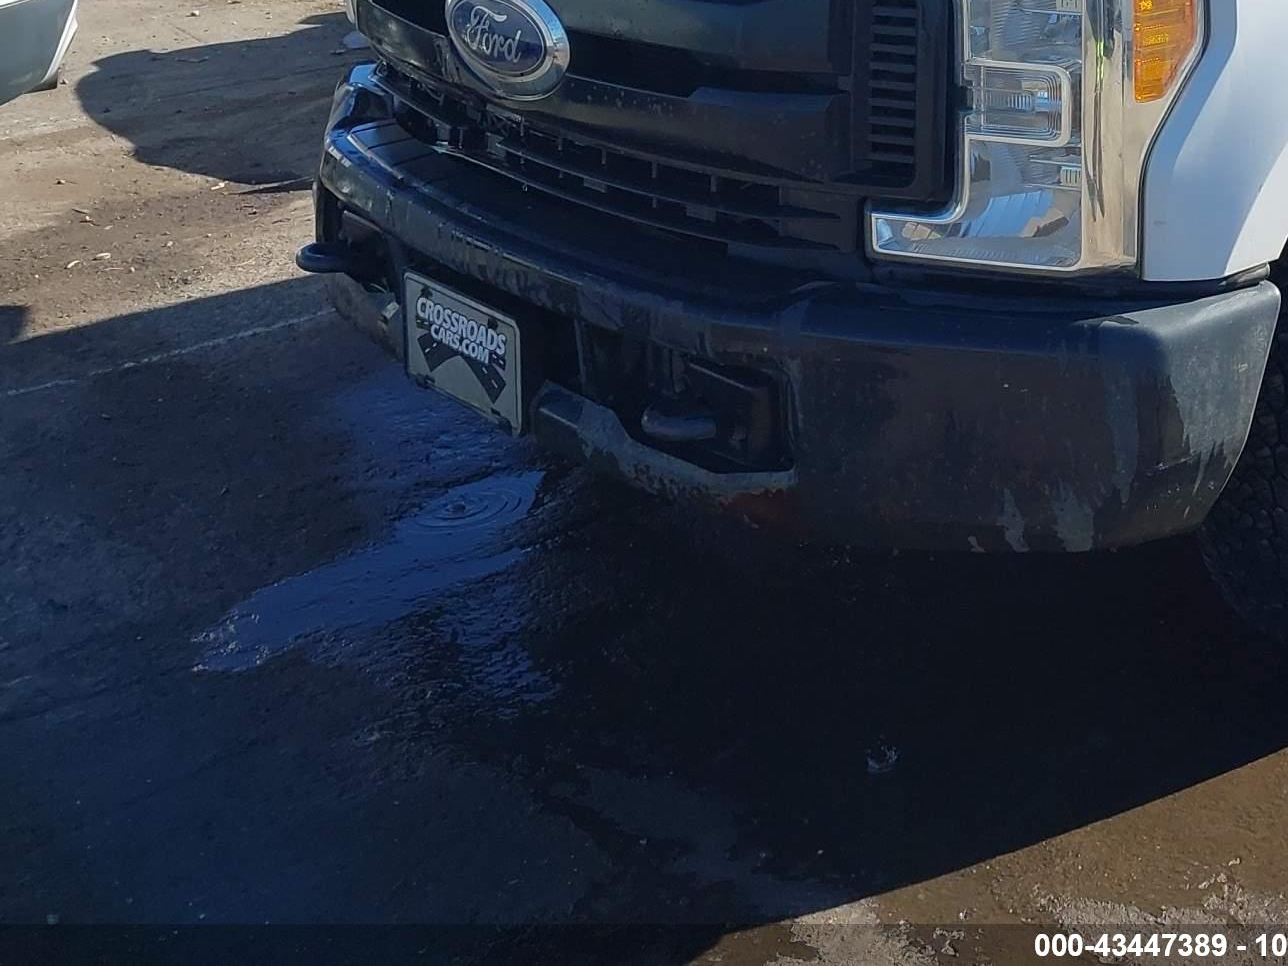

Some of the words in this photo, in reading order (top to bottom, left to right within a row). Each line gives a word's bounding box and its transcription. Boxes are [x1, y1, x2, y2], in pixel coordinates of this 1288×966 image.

[463, 5, 522, 63] Ford
[416, 296, 506, 356] CROSSROADS
[430, 325, 490, 364] CARS.COM
